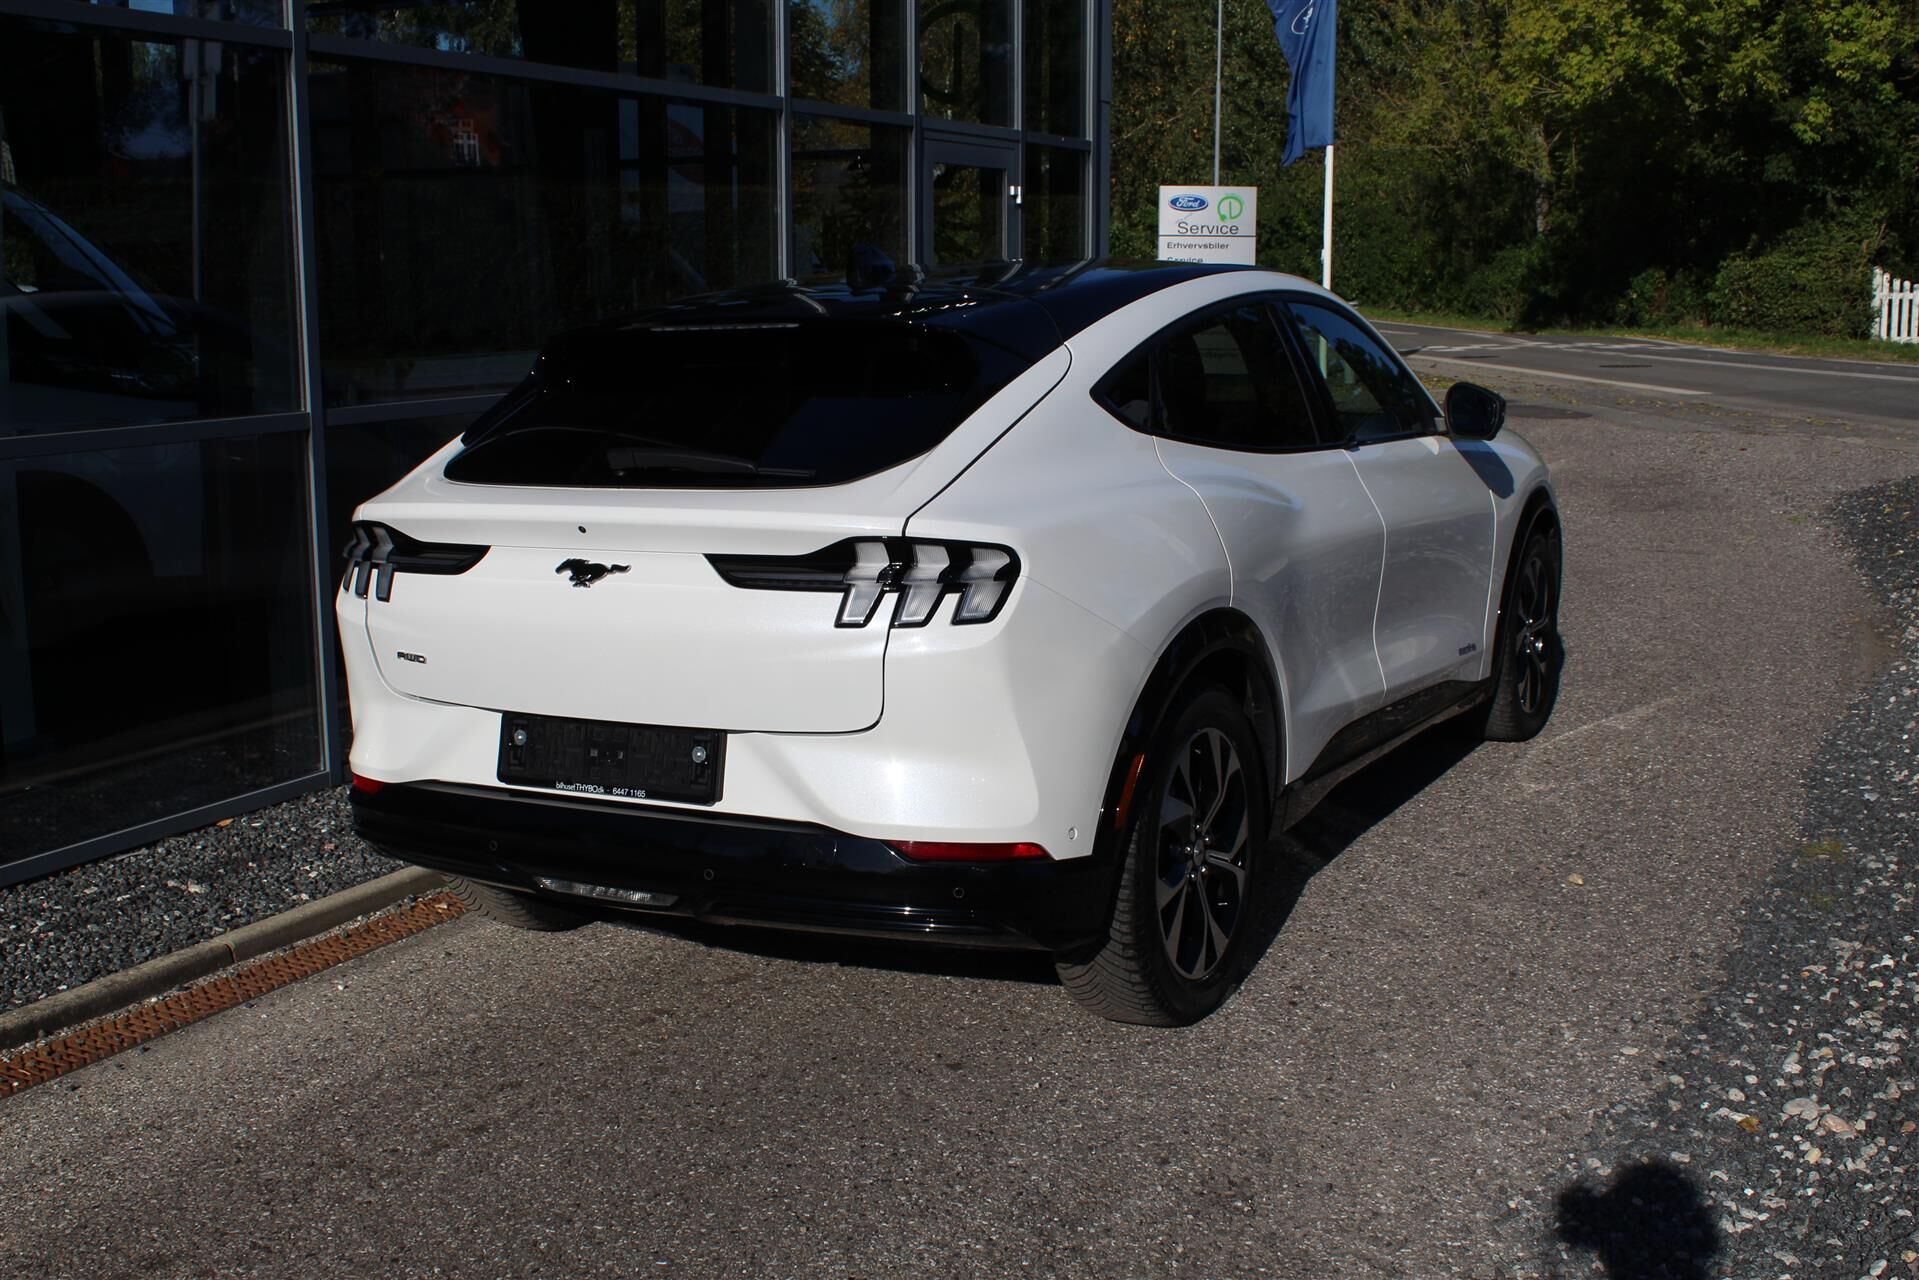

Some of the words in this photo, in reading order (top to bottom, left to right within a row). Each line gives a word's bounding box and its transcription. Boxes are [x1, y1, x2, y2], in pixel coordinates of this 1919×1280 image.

[1176, 197, 1200, 208] Ford
[1177, 221, 1239, 235] Service
[1167, 241, 1229, 250] Erhvervsbiler
[612, 787, 628, 796] 6447
[630, 789, 646, 798] 1165
